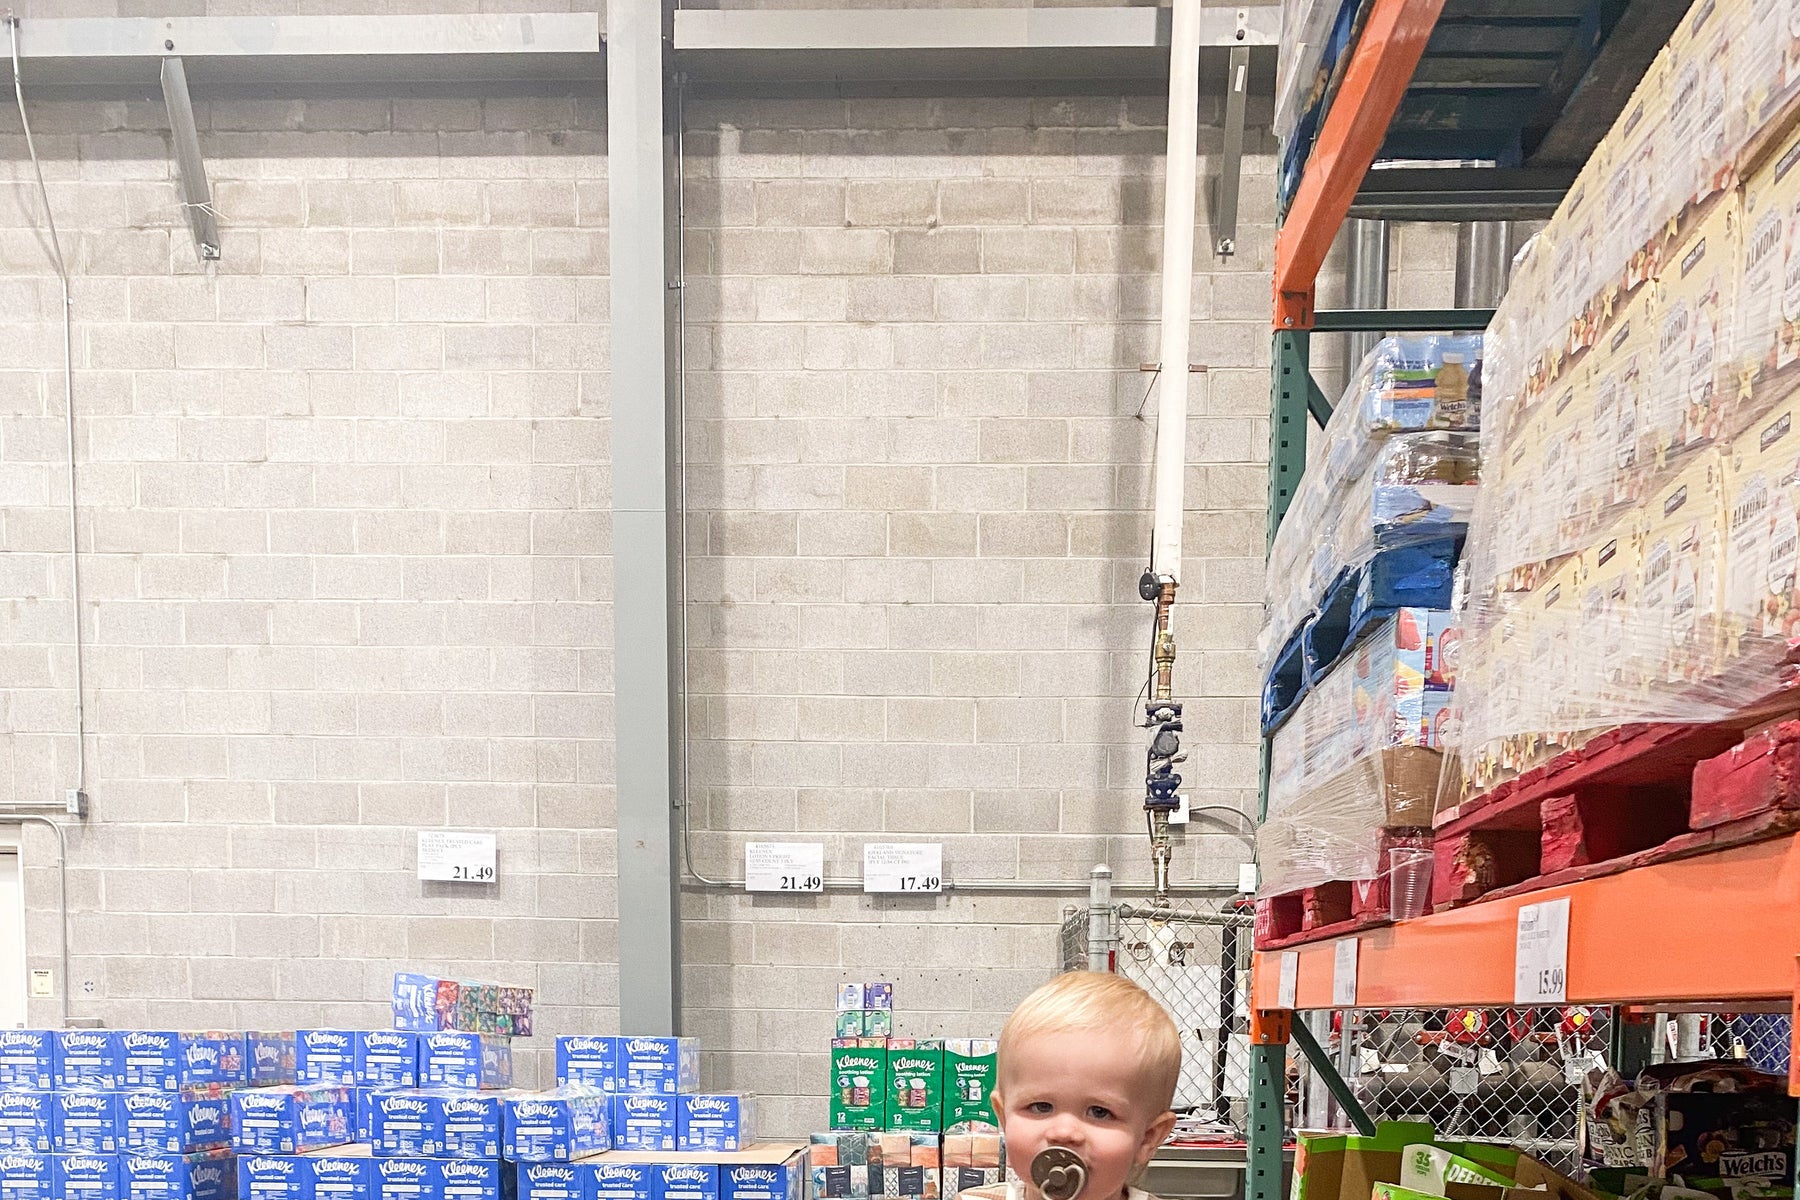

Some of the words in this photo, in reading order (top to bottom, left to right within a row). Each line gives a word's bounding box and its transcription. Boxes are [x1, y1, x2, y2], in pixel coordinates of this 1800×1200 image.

[453, 866, 493, 880] 21.49
[780, 876, 821, 890] 21.49
[900, 876, 939, 890] 17.49
[1538, 968, 1564, 995] 15.99
[60, 1032, 107, 1050] Kleenex
[122, 1032, 170, 1050] Kleenex
[302, 1031, 348, 1048] Kleenex
[362, 1033, 408, 1050] Kleenex
[427, 1034, 472, 1051] Kleenex
[564, 1037, 609, 1055] Kleenex
[624, 1039, 669, 1056] Kleenex
[186, 1043, 217, 1068] Kleenex
[836, 1055, 879, 1069] Kleenex
[892, 1057, 935, 1071] Kleenex
[955, 1062, 990, 1073] Kleenex
[60, 1094, 106, 1112] Kleenex
[124, 1095, 172, 1112] Kleenex
[239, 1095, 286, 1111] Kleenex
[380, 1097, 428, 1114] Kleenex
[441, 1098, 490, 1115] Kleenex
[511, 1101, 558, 1119] Kleenex
[624, 1096, 668, 1113] Kleenex
[685, 1097, 731, 1115] Kleenex
[189, 1104, 219, 1126] Kleenex
[60, 1157, 108, 1175] Kleenex
[126, 1157, 174, 1176] Kleenex
[247, 1158, 295, 1176] Kleenex
[311, 1158, 359, 1176] Kleenex
[1416, 1151, 1431, 1166] 35
[1722, 1155, 1785, 1176] Welch's
[378, 1159, 427, 1176] Kleenex
[440, 1160, 488, 1178] Kleenex
[526, 1164, 574, 1181] Kleenex
[593, 1165, 641, 1182] Kleenex
[660, 1166, 709, 1183] Kleenex
[730, 1167, 778, 1184] Kleenex
